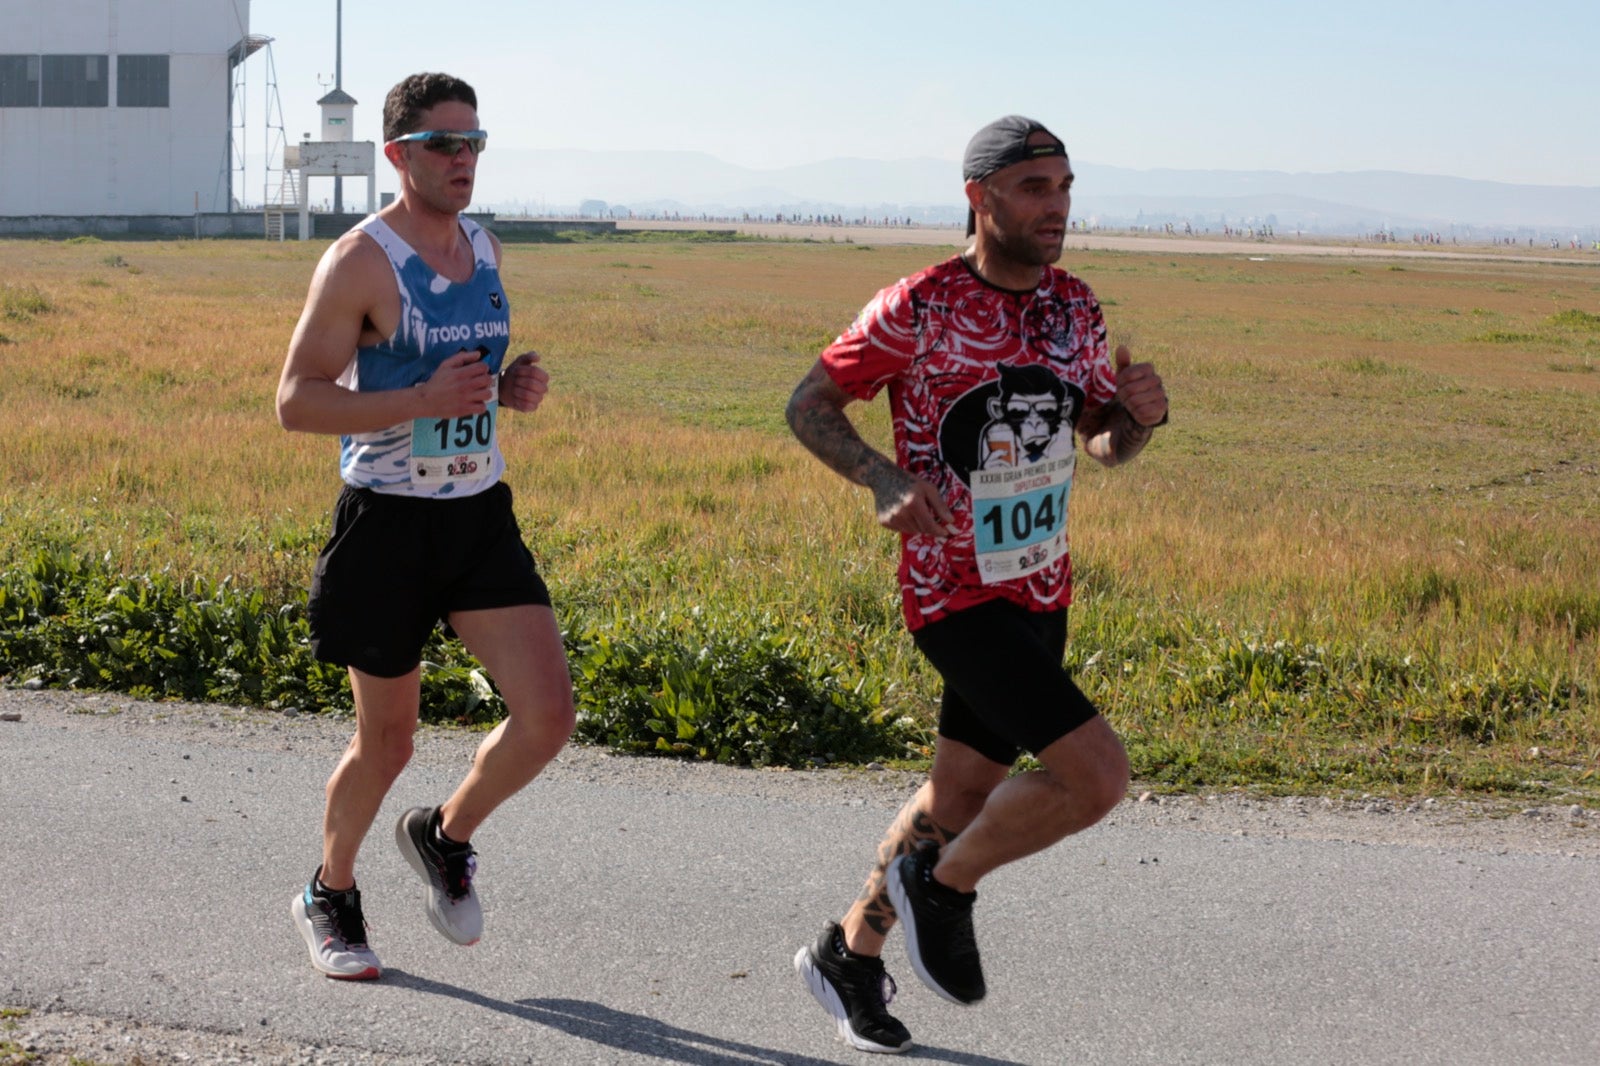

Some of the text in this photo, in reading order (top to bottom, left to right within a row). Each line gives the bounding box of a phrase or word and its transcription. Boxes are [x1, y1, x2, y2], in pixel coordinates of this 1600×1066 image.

[429, 320, 509, 345] TODO SUMA
[434, 409, 492, 450] 150
[1003, 470, 1023, 483] GRAN
[1024, 462, 1047, 477] PREMIO
[1048, 461, 1057, 472] DE
[983, 487, 1067, 545] 1041
